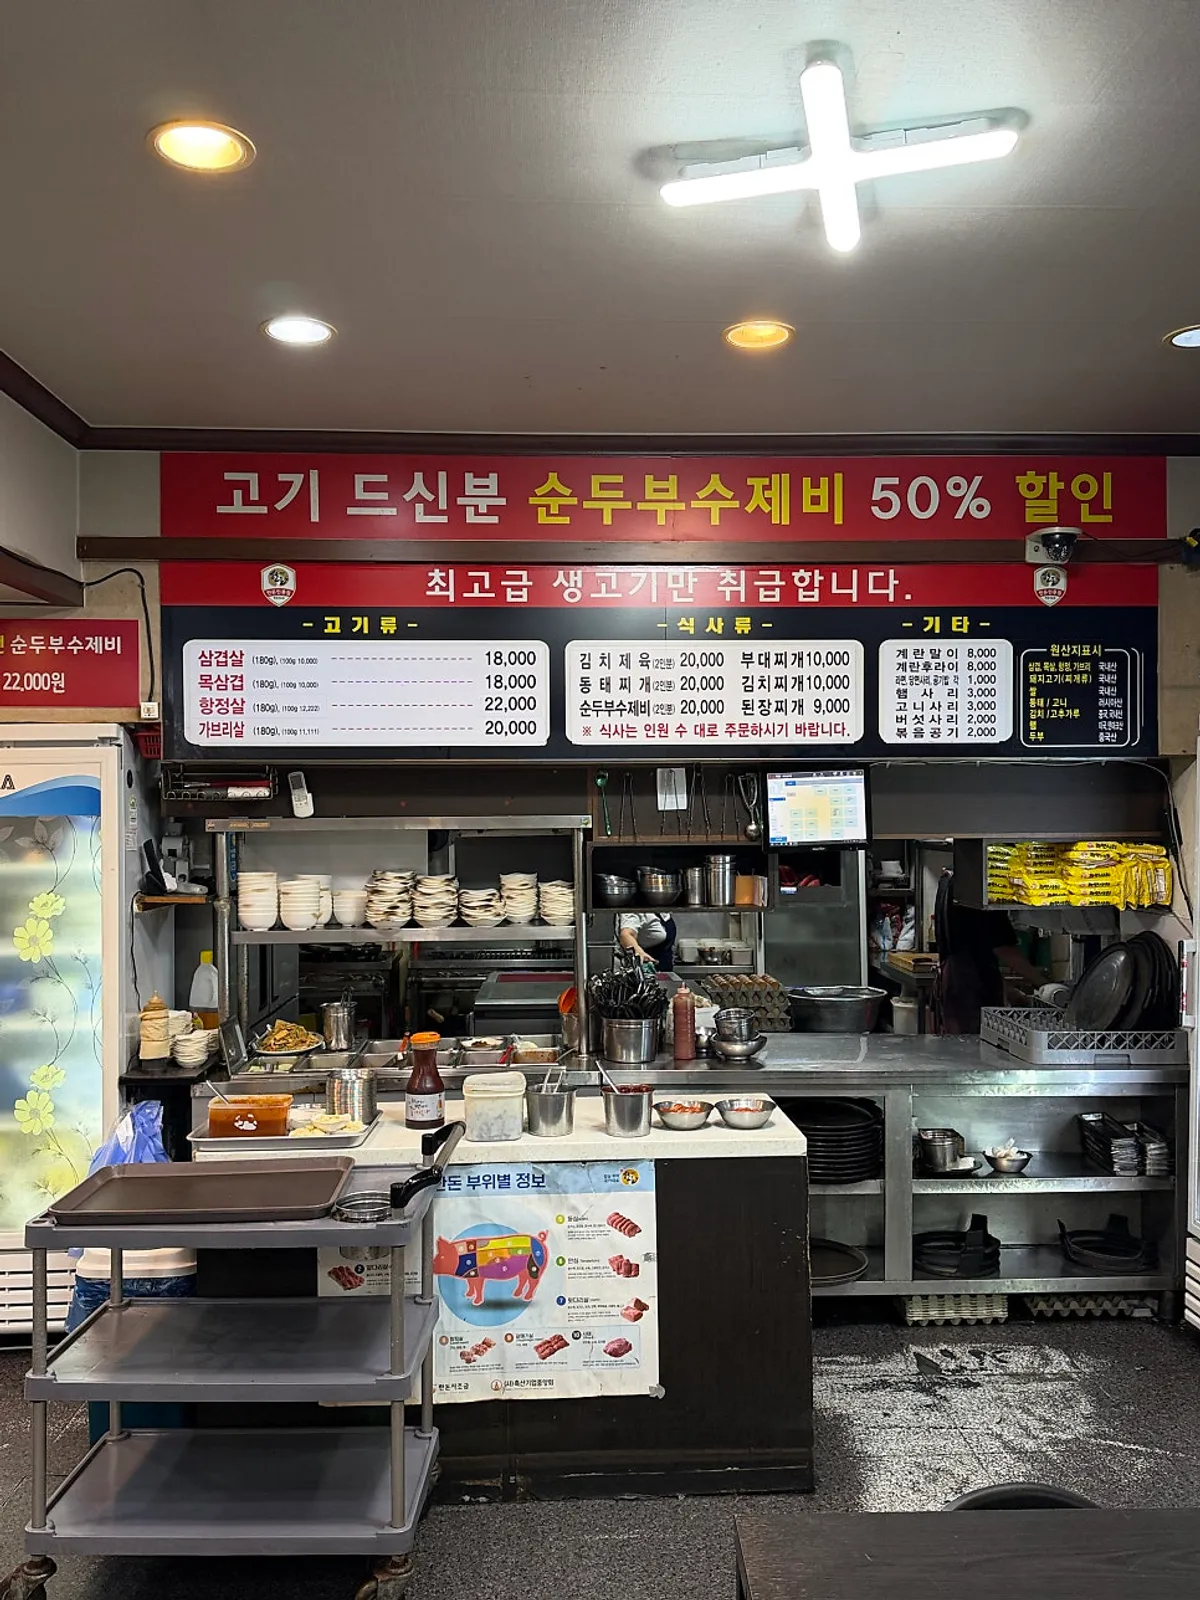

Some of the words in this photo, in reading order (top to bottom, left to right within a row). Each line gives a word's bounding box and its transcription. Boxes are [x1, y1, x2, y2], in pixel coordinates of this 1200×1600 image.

[217, 470, 319, 522] 고기
[347, 472, 506, 523] 드신분
[529, 471, 845, 525] 순두부수제비
[871, 476, 990, 519] 50%
[1016, 471, 1113, 525] 할인
[426, 568, 532, 603] 최고급
[552, 569, 698, 603] 생고기만
[717, 569, 913, 603] 취급합니다.
[324, 617, 397, 633] 고기류
[677, 617, 752, 634] 식사류
[923, 617, 969, 633] 기타
[11, 635, 121, 654] 순두부수제비
[1050, 644, 1101, 656] 원산지표시
[198, 650, 244, 667] 삼겹살
[486, 651, 536, 667] 18,000
[680, 652, 724, 668] 20,000
[741, 651, 803, 669] 부대찌개
[807, 651, 849, 668] 10,000
[896, 648, 958, 660] 계란말이
[967, 648, 996, 658] 8,000
[896, 661, 958, 672] 계란후라이
[967, 661, 996, 672] 8,000
[3, 673, 64, 693] 22,000원
[198, 674, 243, 691] 목삼겹
[486, 675, 536, 690] 18,000
[681, 676, 724, 692] 20,000
[742, 675, 803, 692] 김치찌개
[807, 675, 849, 691] 10,000
[967, 675, 996, 685] 1,000
[967, 688, 996, 698] 3,000
[200, 697, 245, 715] 항정살
[485, 696, 536, 712] 22,000
[580, 700, 650, 717] 순두부수제비
[681, 700, 724, 716] 20,000
[742, 699, 803, 716] 된장찌개
[814, 699, 849, 715] 9,000
[896, 701, 958, 712] 고니사리
[967, 701, 996, 712] 3,000
[1052, 698, 1067, 708] 고니
[896, 714, 958, 726] 버섯사리
[967, 714, 996, 724] 2,000
[199, 721, 244, 738] 가브리살
[486, 721, 536, 736] 20,000
[600, 724, 637, 738] 식사는
[644, 723, 668, 738] 인원
[675, 723, 687, 738] 수
[695, 724, 718, 737] 대로
[725, 723, 788, 737] 주문하시기
[795, 722, 849, 737] 바랍니다.
[896, 727, 958, 738] 볶음공기
[967, 727, 996, 738] 2,000
[1029, 732, 1044, 742] 두부
[466, 1172, 511, 1190] 부위별
[516, 1171, 546, 1189] 정보
